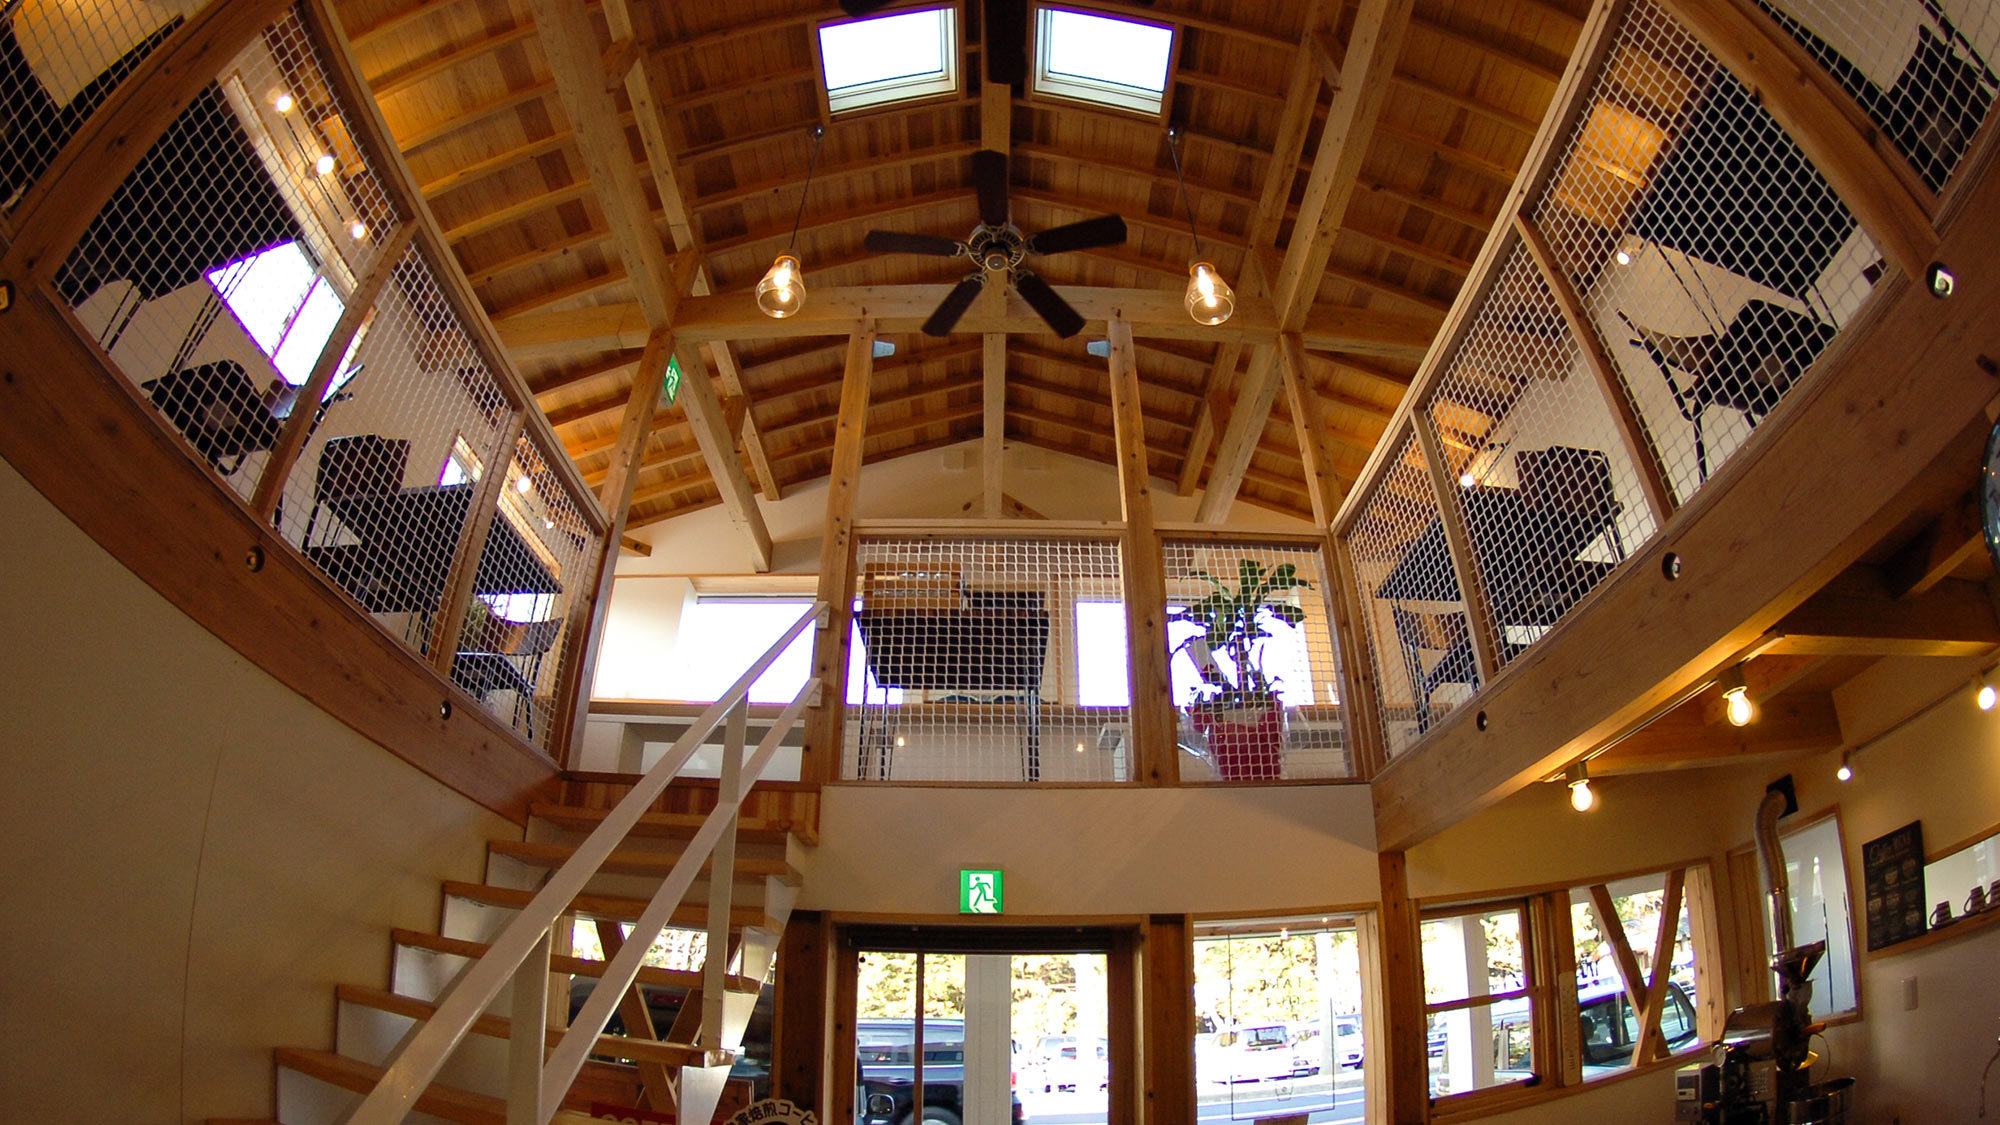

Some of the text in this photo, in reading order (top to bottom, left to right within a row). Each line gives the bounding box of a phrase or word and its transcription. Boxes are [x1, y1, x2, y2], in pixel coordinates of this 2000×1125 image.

[726, 1102, 814, 1125] 家焙煎コーヒ
